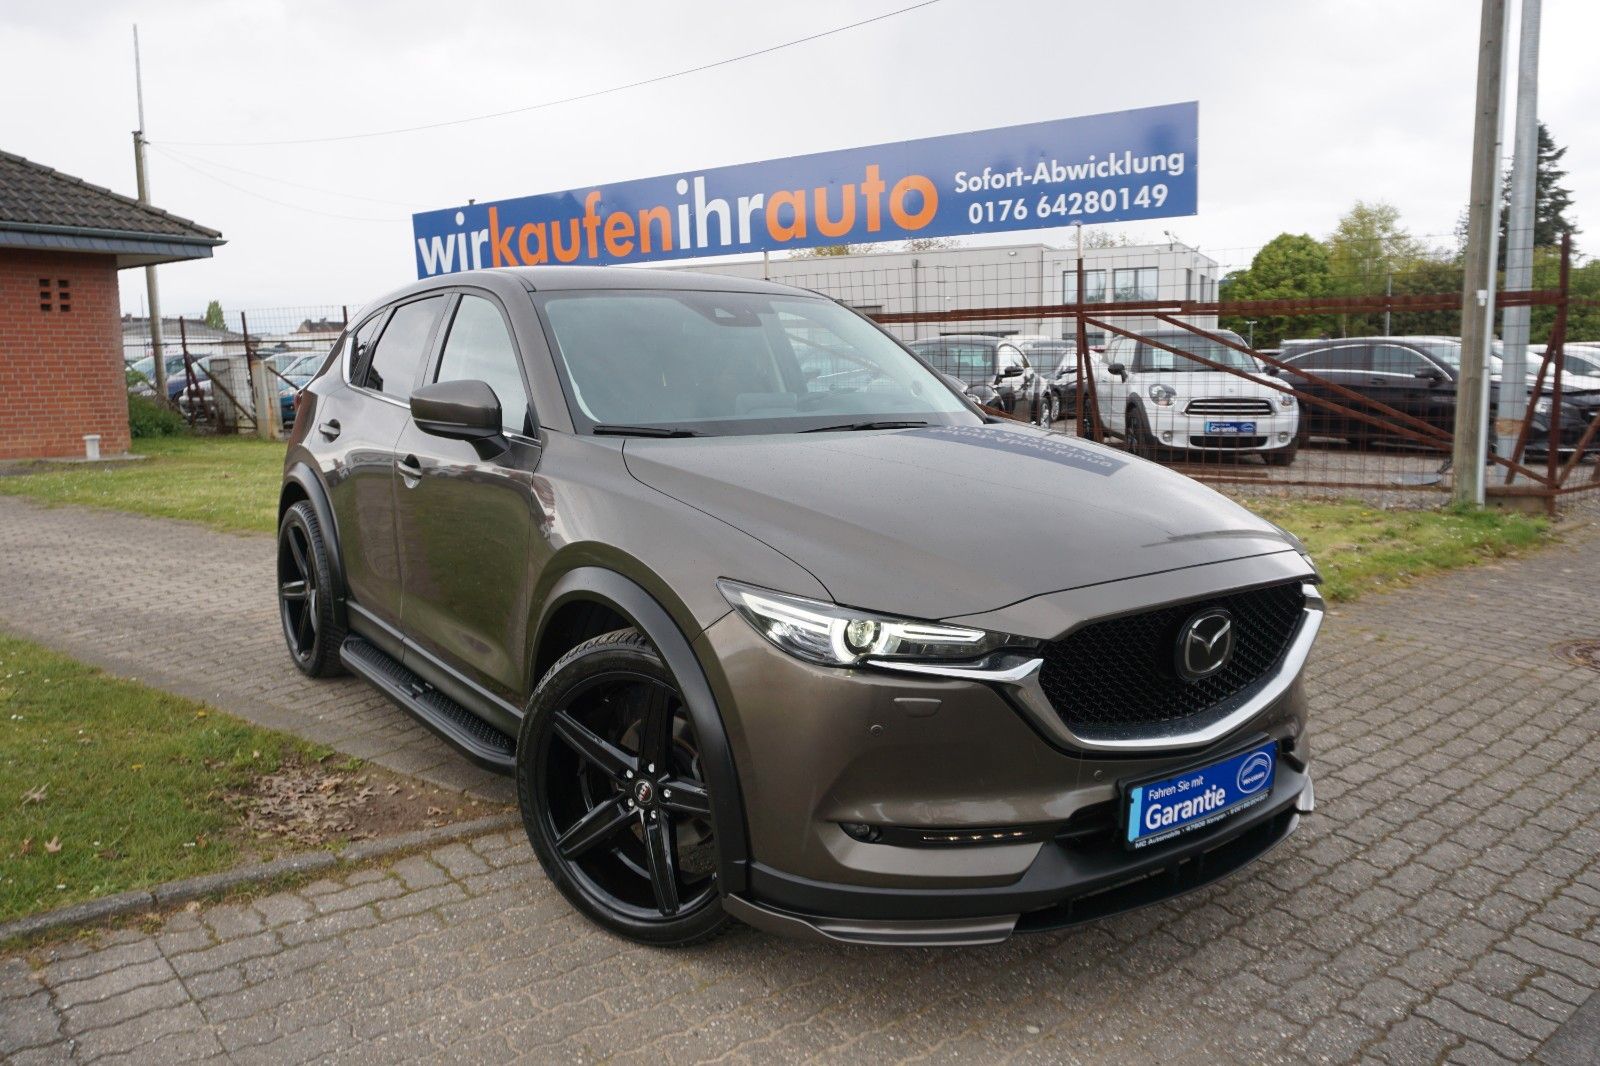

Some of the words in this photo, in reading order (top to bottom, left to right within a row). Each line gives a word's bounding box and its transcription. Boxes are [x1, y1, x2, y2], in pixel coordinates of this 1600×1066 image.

[954, 150, 1185, 193] Sofort-Abwicklung
[968, 199, 1028, 225] 0176
[1036, 183, 1169, 219] 64280149
[1145, 785, 1226, 830] Garantie
[1148, 783, 1176, 801] Fahren
[1177, 780, 1190, 792] Sie
[1191, 775, 1204, 790] mit
